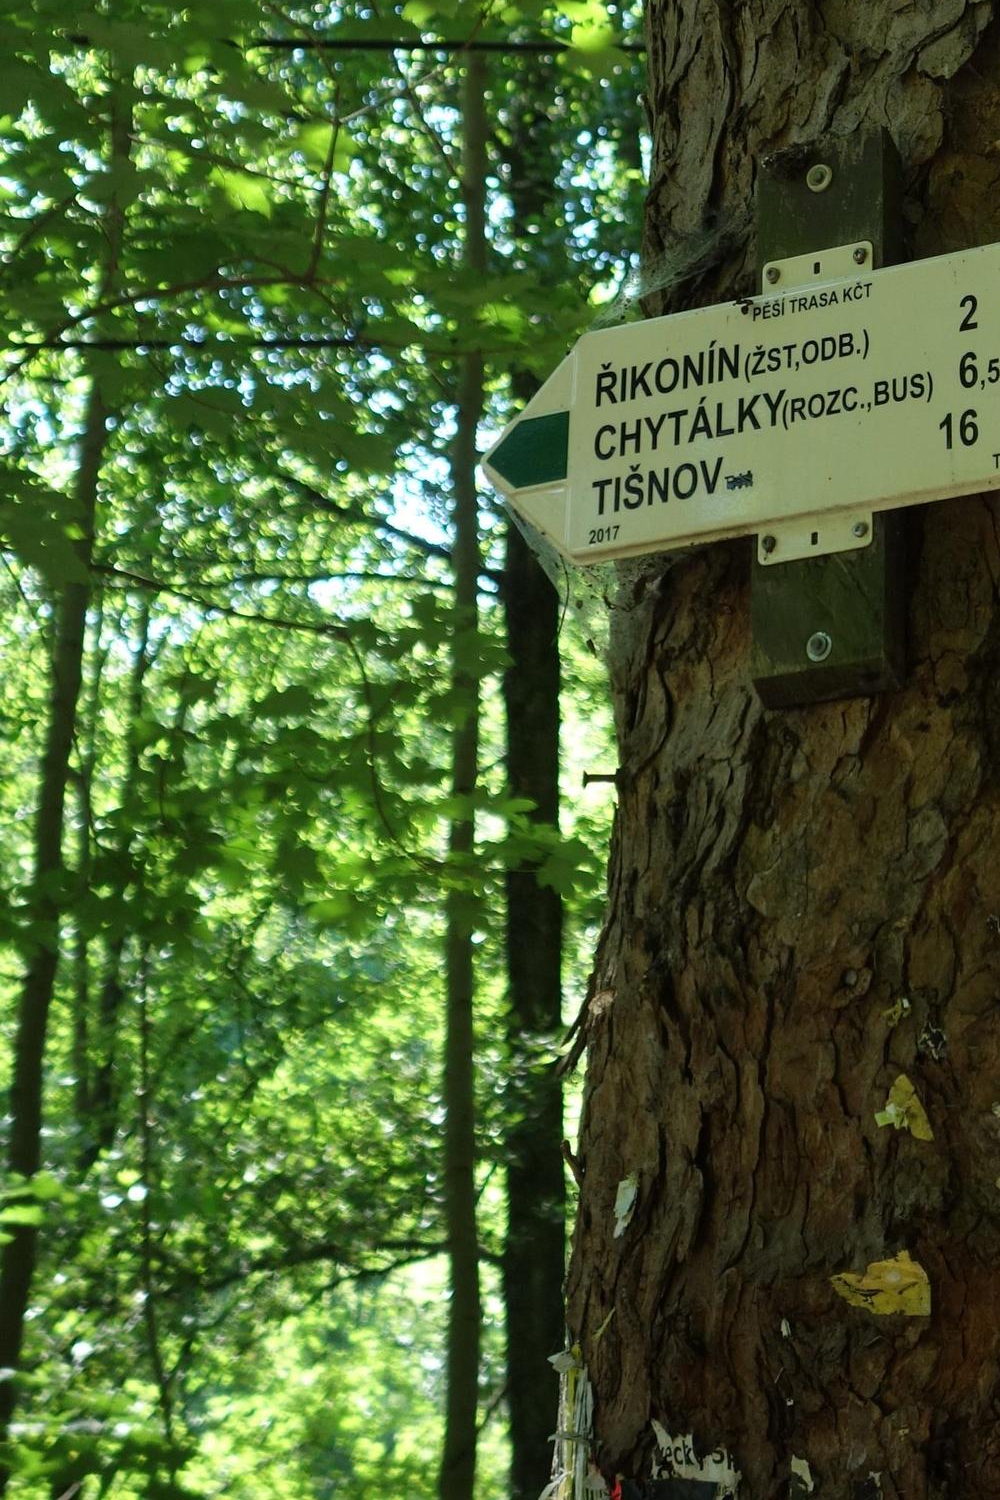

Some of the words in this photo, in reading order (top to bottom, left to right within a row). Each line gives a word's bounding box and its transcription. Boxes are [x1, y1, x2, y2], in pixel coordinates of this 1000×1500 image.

[752, 301, 785, 322] PĚŠÍ
[789, 290, 840, 313] TRASA
[842, 282, 873, 302] KČT
[959, 295, 978, 332] 2
[959, 351, 1000, 391] 6,5
[593, 457, 723, 516] TIŠNOV
[939, 409, 979, 450] 16
[588, 526, 620, 545] 2017
